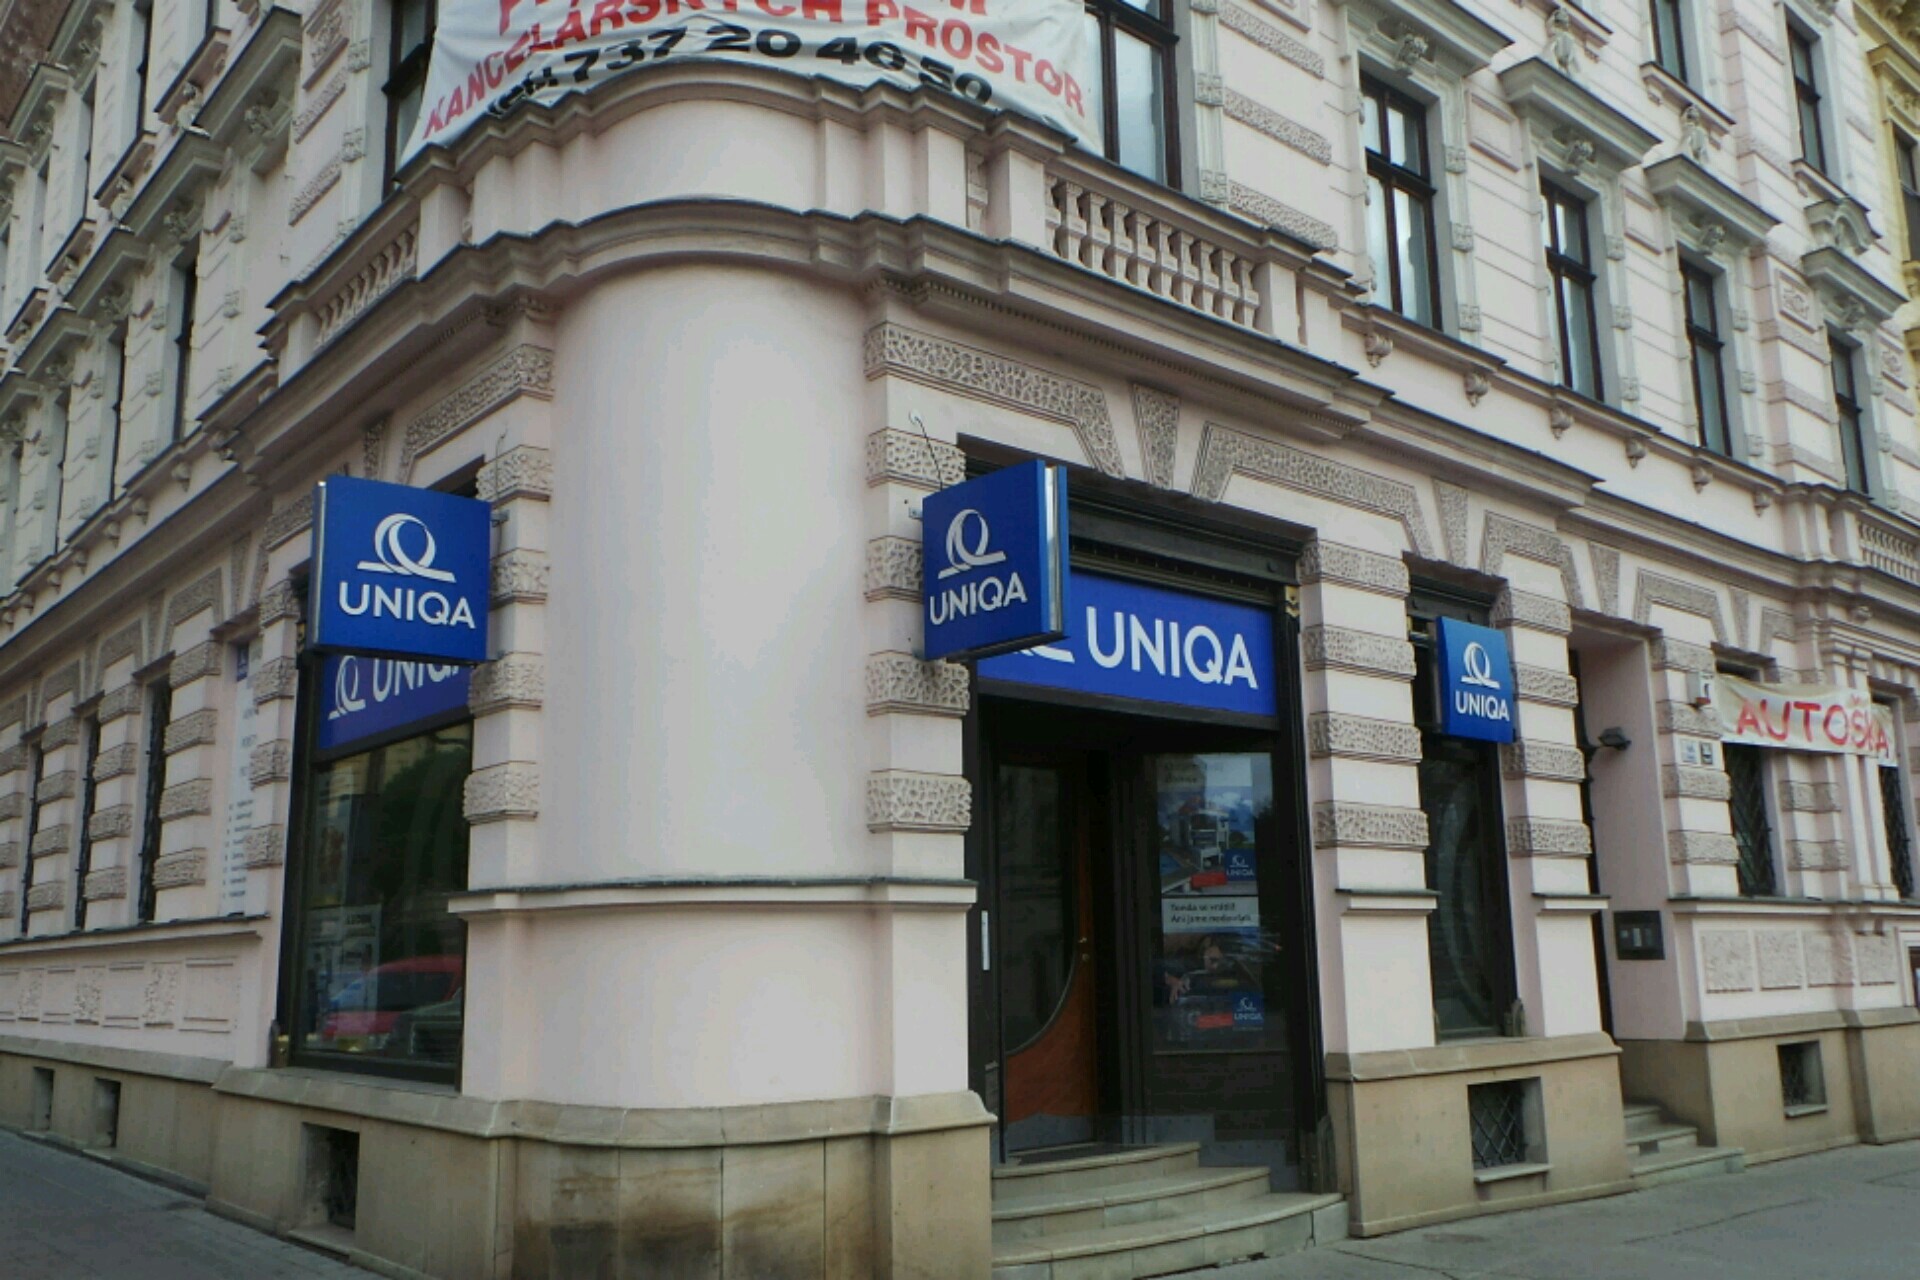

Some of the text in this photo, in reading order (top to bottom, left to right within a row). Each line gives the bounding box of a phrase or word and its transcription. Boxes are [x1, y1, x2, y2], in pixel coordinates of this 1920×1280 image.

[564, 26, 689, 84] 737
[706, 24, 802, 58] 20
[918, 54, 993, 104] 50
[338, 581, 476, 629] UNIQA
[928, 571, 1028, 625] UNIQA
[1086, 605, 1259, 690] UNIQA
[1455, 690, 1510, 722] UNIQA
